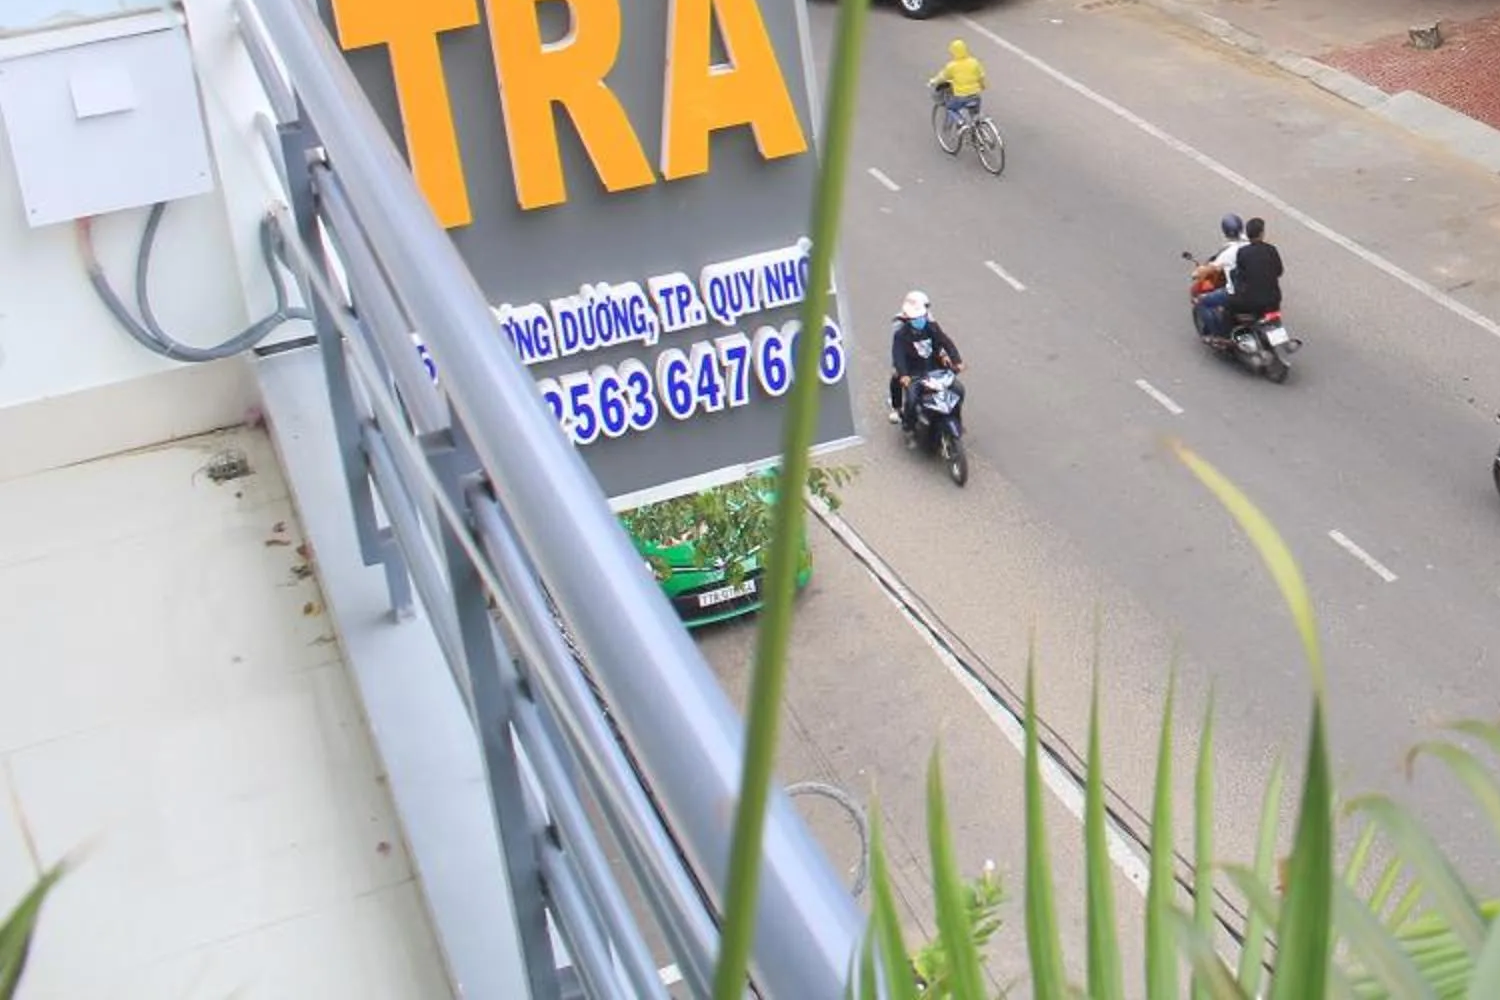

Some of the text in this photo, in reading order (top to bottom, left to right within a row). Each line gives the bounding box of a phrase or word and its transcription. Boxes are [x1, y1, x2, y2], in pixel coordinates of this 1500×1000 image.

[560, 293, 654, 351] DƯƠNG,
[659, 283, 701, 323] TP.
[709, 268, 756, 320] QUY
[666, 346, 746, 415] 647
[763, 325, 841, 391] 66
